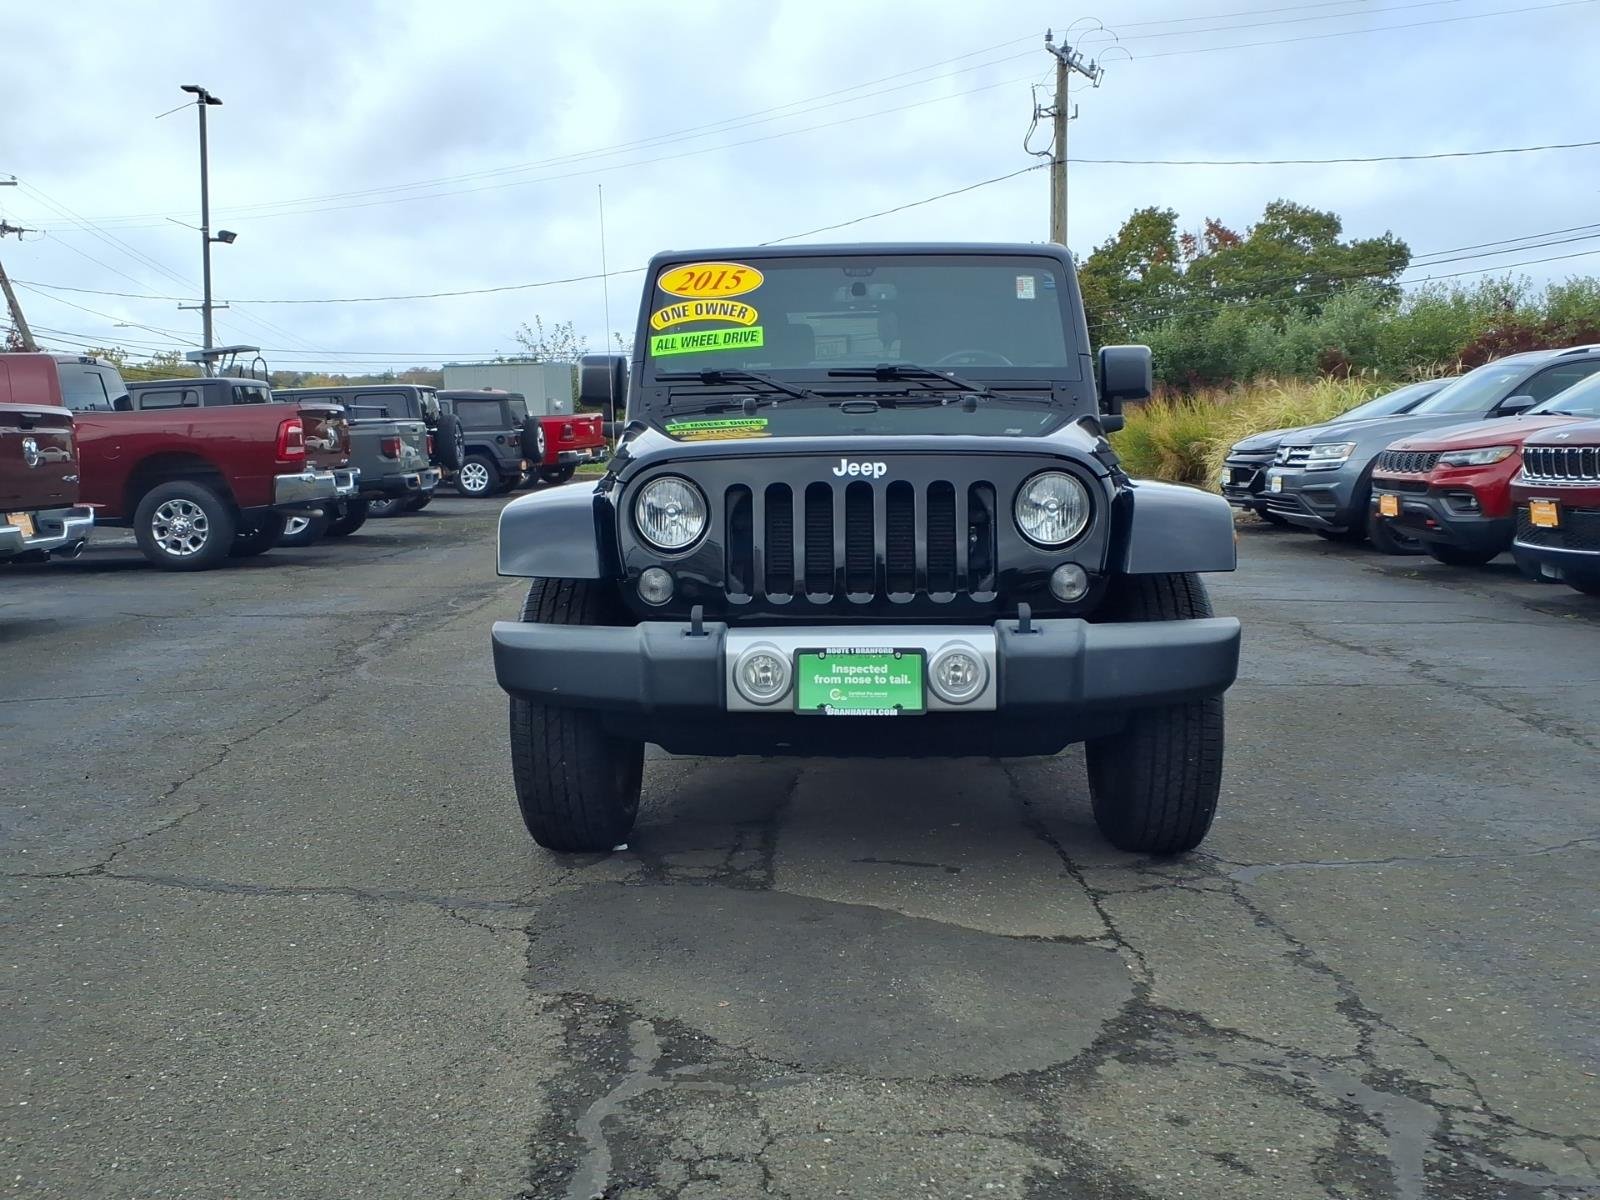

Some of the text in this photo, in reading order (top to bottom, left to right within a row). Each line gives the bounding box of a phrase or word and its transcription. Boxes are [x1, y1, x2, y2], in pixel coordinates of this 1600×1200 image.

[675, 269, 747, 292] 2015
[660, 302, 748, 323] ONE OWNER
[655, 330, 758, 351] ALL WHEEL DRIVE
[832, 458, 888, 479] Jeep
[814, 674, 911, 684] from nose to tail.
[831, 664, 888, 675] Inspected
